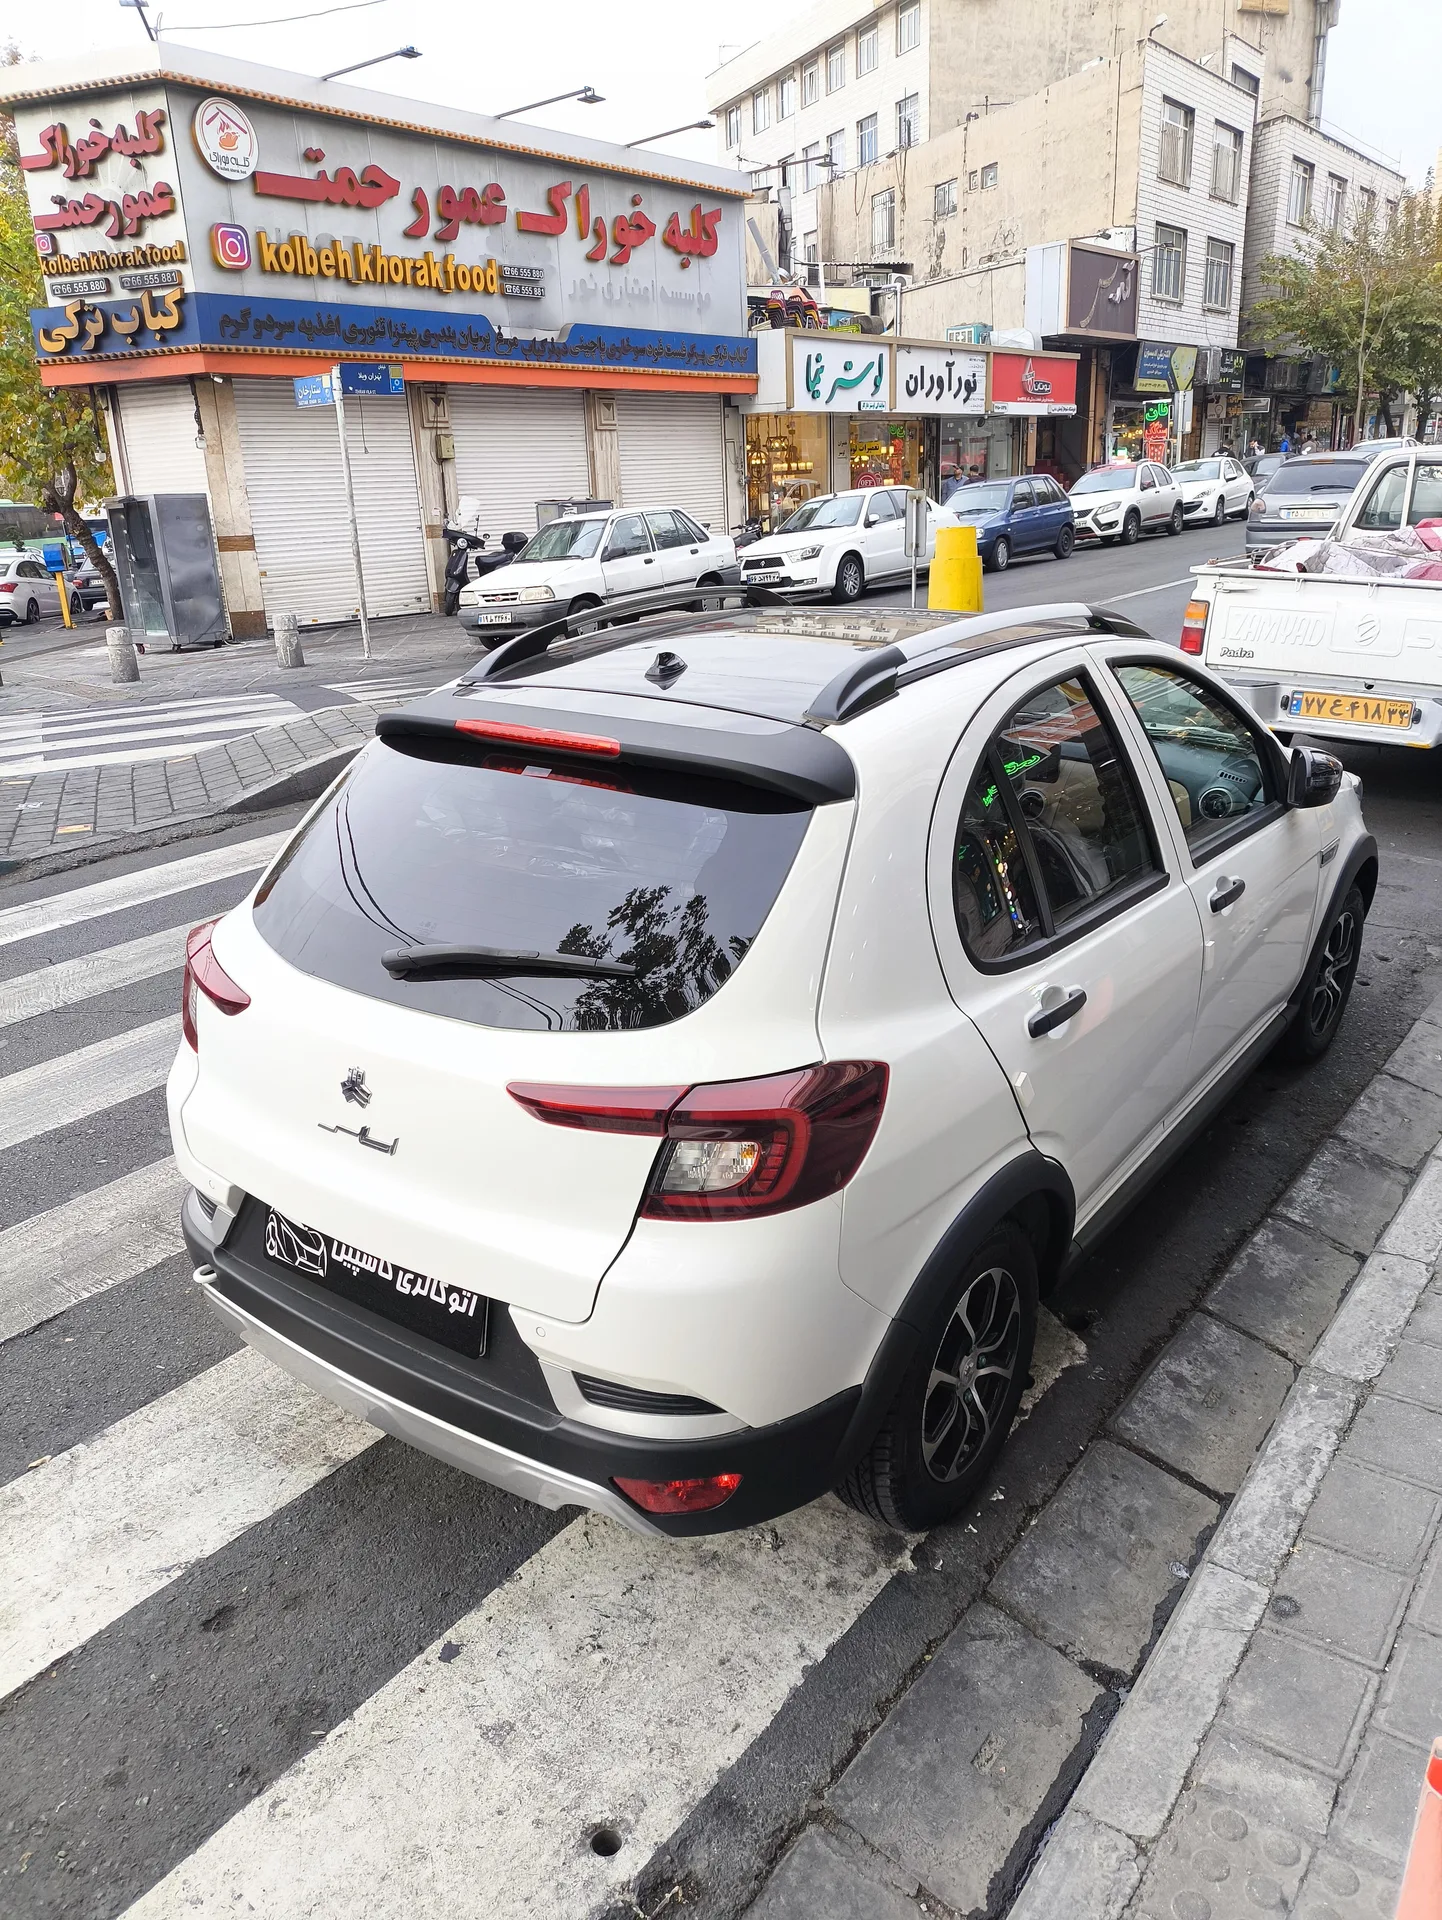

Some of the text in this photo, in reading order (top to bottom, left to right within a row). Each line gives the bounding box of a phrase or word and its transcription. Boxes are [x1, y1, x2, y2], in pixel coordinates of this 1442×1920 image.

[21, 109, 165, 179] کلبه خوراک
[34, 181, 175, 237] عمو رحمت
[254, 146, 722, 269] کلبه خوراک عمو رحمت
[131, 272, 177, 286] 66 555 881
[510, 267, 519, 276] 66
[519, 268, 532, 278] 555
[62, 279, 105, 294] 66 555 880
[521, 286, 533, 295] 555
[39, 287, 185, 353] کباب ترکی
[219, 307, 251, 339] گرم
[298, 312, 341, 342] اغذیه
[341, 316, 386, 345] تنوری
[387, 317, 419, 352] پیتزا
[419, 325, 457, 349] بندری
[646, 337, 664, 363] فود
[665, 340, 687, 360] فست
[706, 343, 728, 367] ترکی
[728, 344, 750, 367] کباب
[297, 384, 322, 399] ستارخان
[1227, 612, 1327, 648] ZAMYAD
[1220, 647, 1254, 659] Padra
